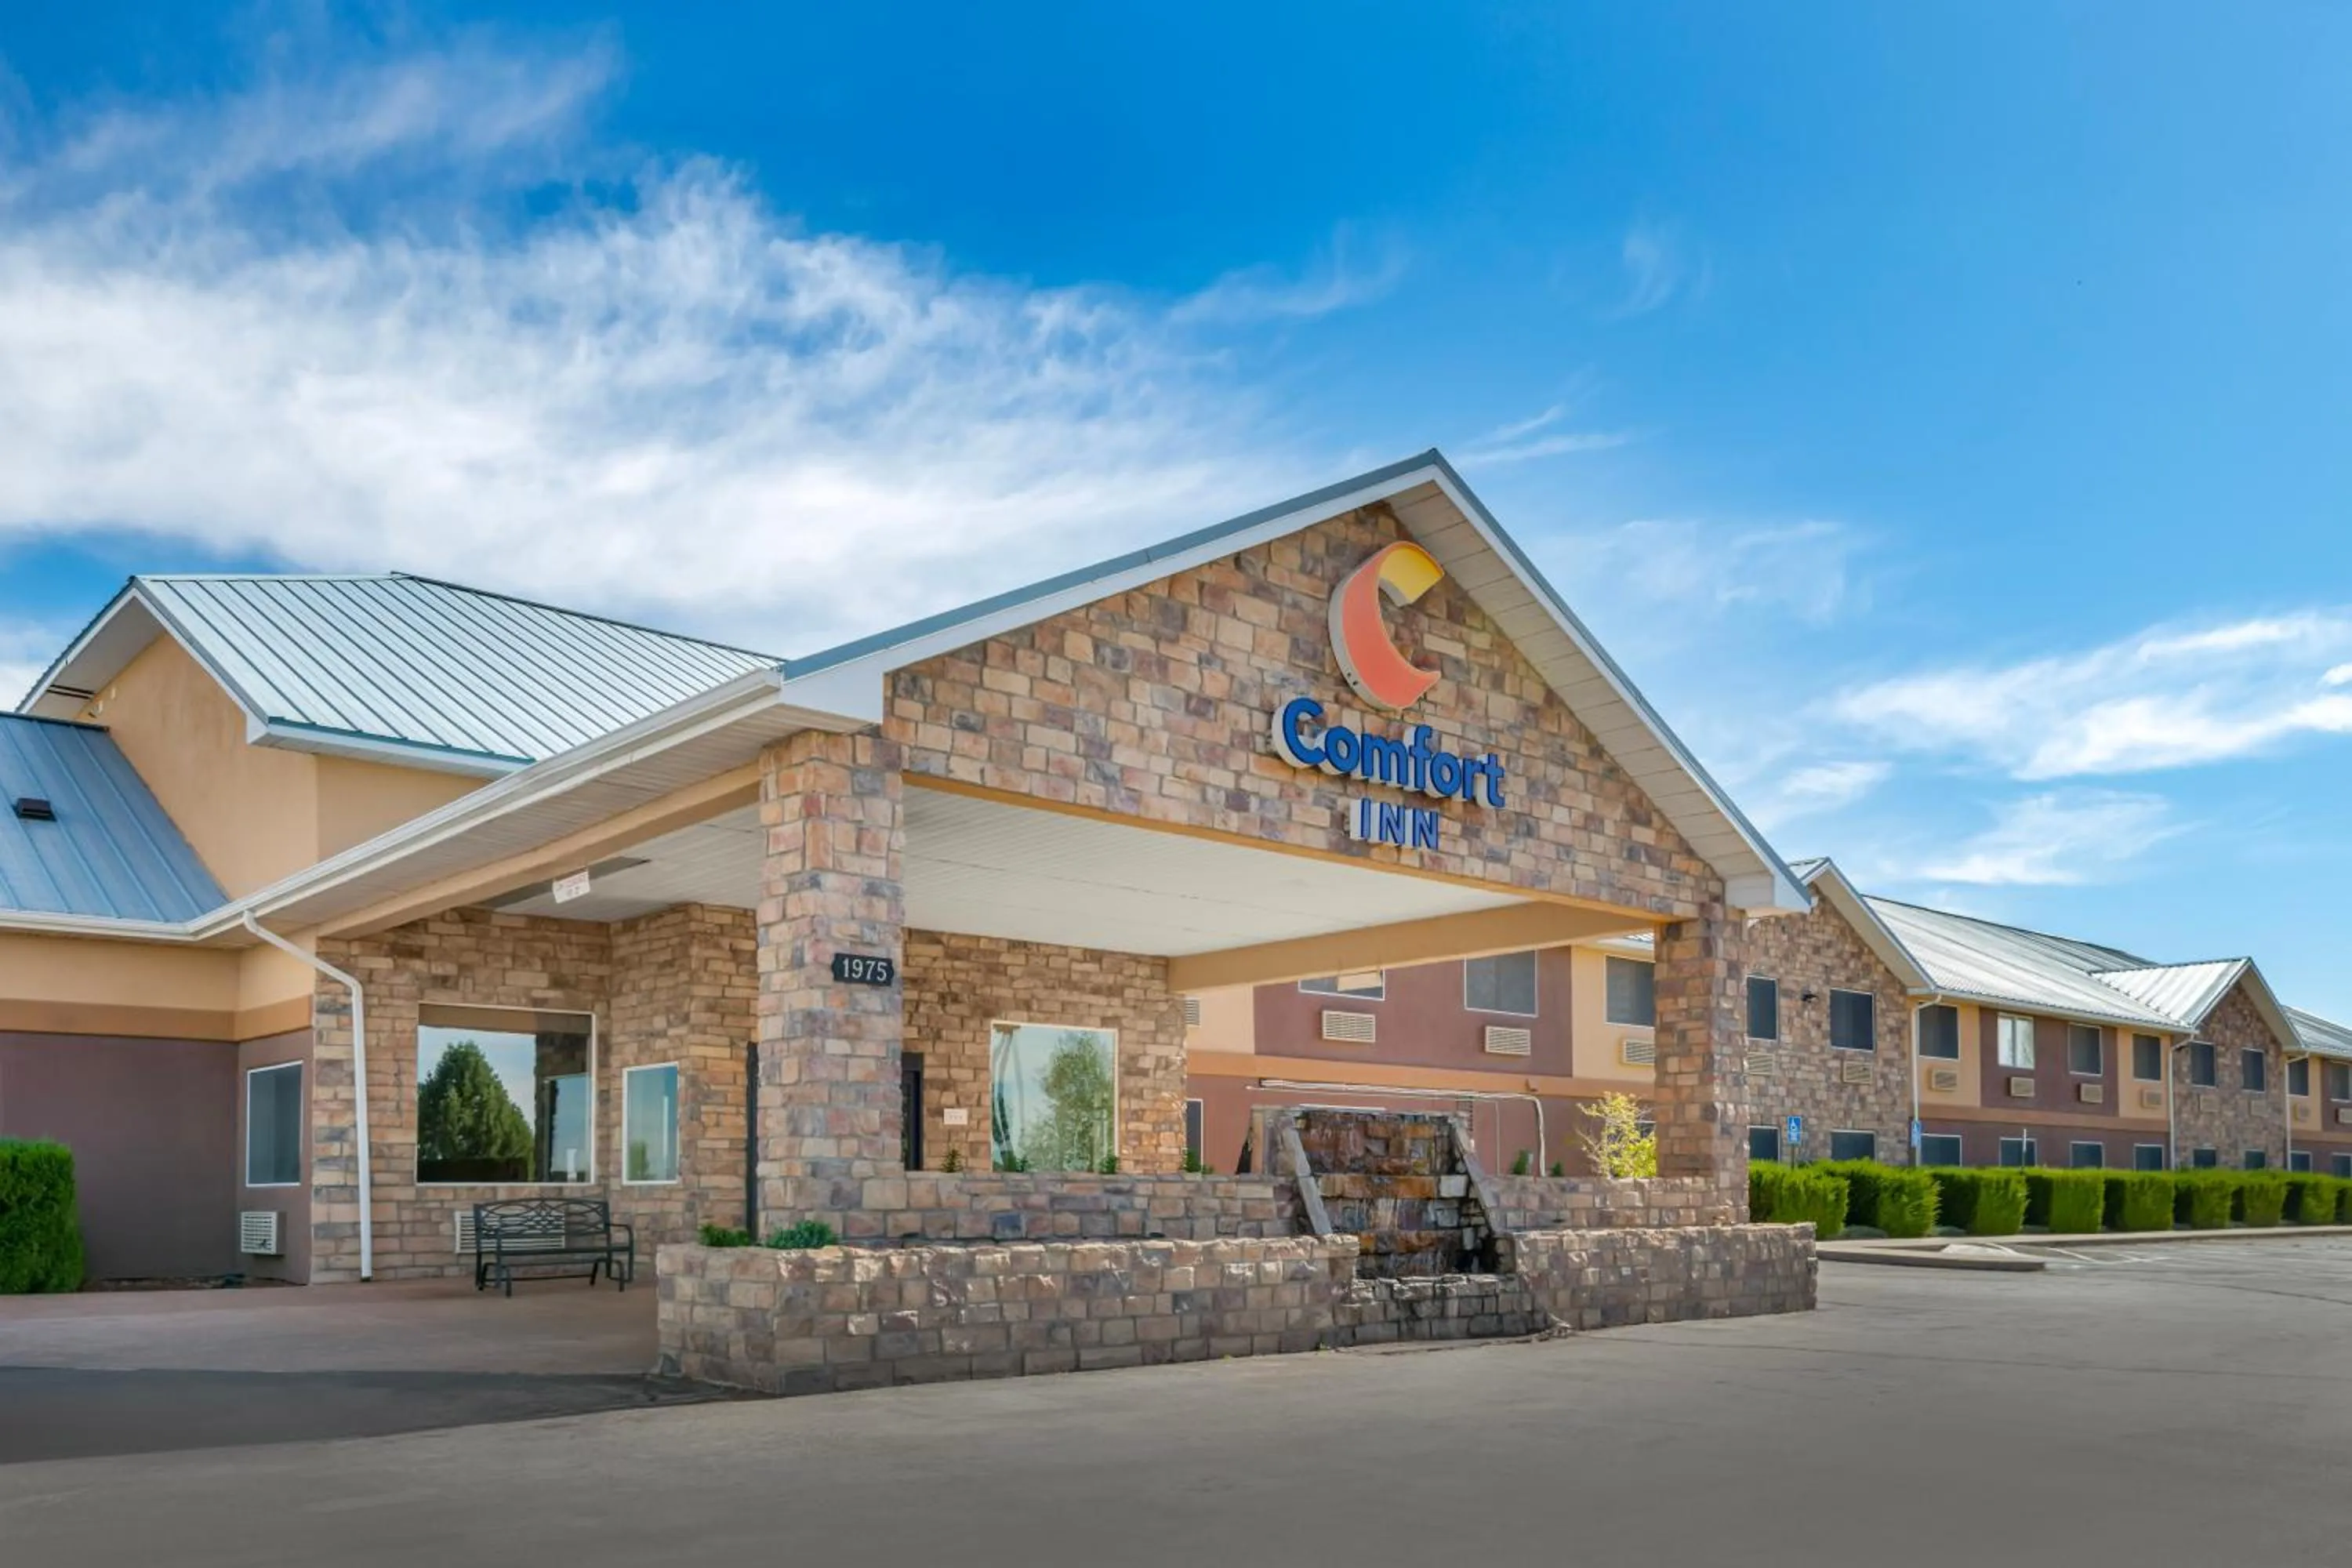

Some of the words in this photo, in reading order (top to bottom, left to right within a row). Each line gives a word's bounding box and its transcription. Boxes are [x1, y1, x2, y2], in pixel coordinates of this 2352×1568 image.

[1280, 696, 1505, 808] Comfort
[1359, 797, 1439, 851] INN
[842, 957, 887, 982] 1975
